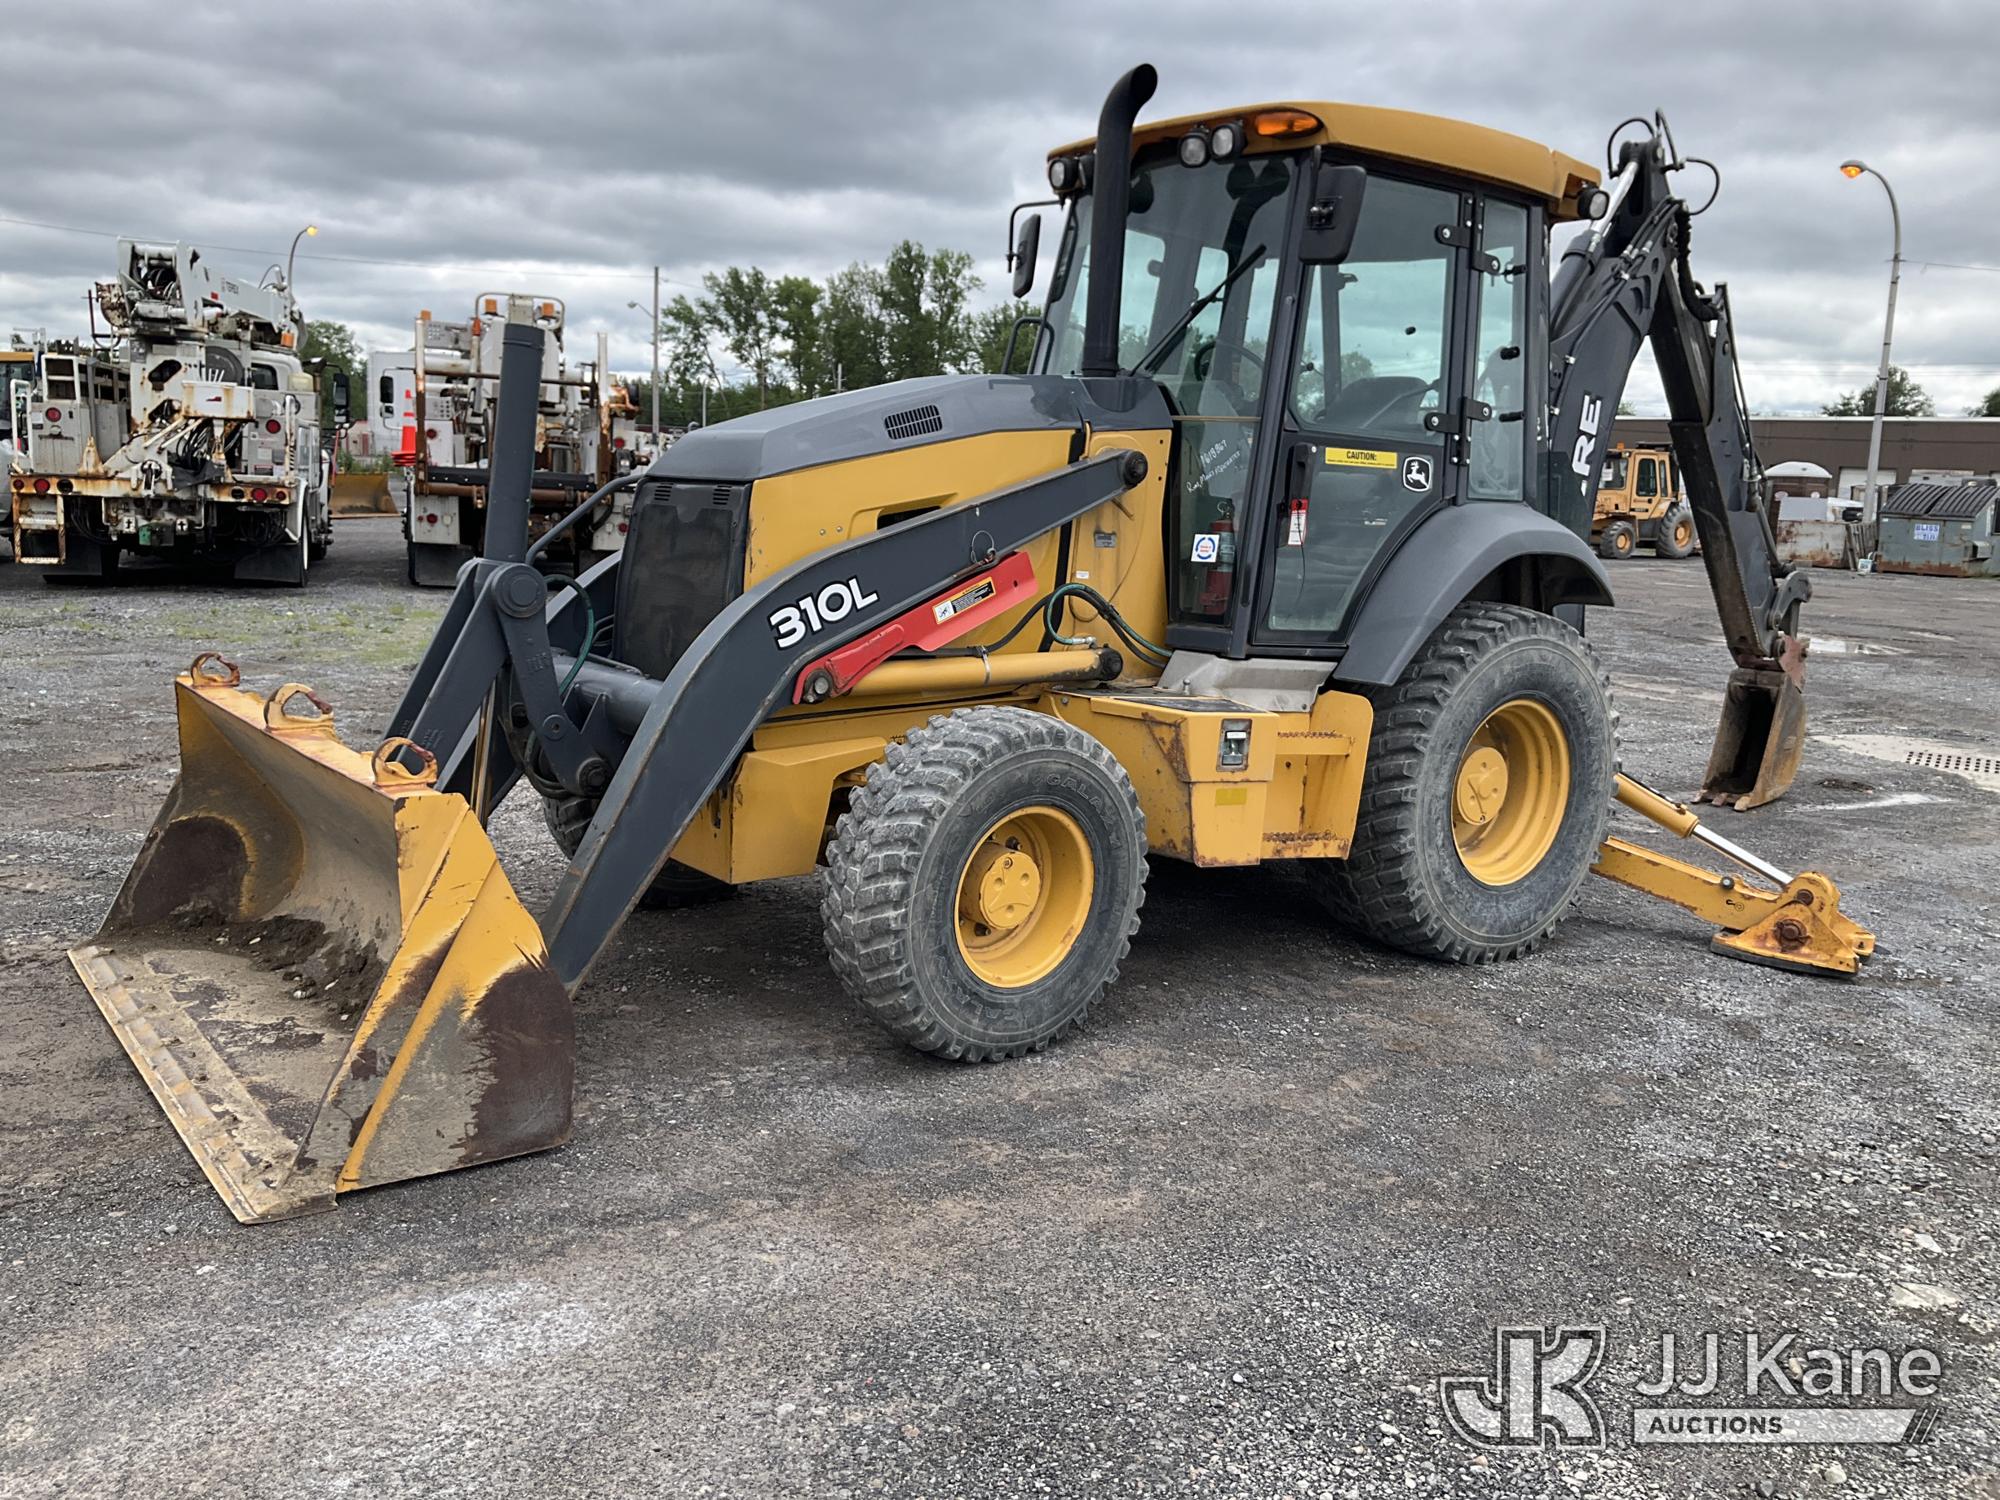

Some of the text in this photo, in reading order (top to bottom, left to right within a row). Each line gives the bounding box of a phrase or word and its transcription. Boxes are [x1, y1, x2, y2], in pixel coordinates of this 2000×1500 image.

[1346, 450, 1377, 461] CAUTION:
[1572, 394, 1602, 497] RE
[769, 577, 879, 648] 310L
